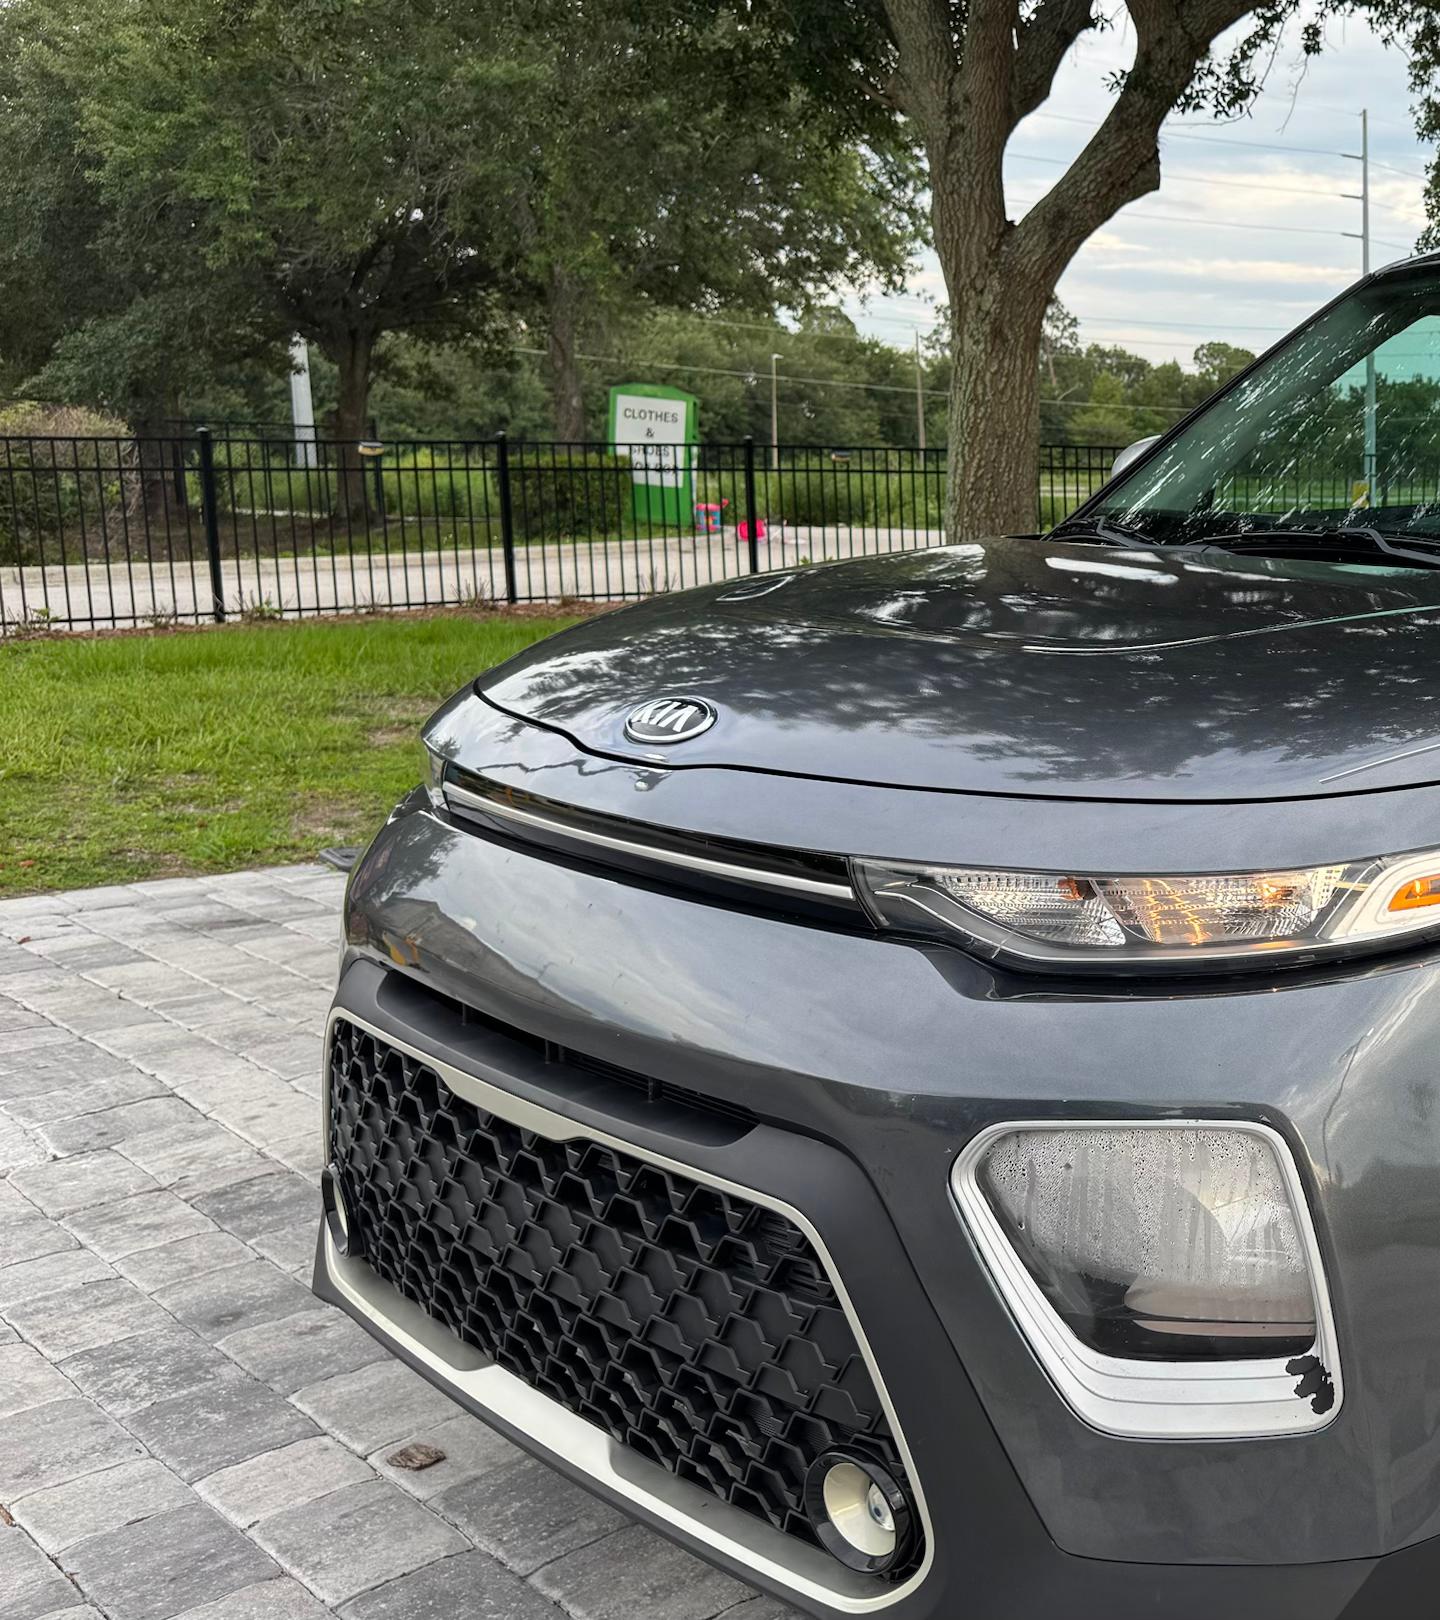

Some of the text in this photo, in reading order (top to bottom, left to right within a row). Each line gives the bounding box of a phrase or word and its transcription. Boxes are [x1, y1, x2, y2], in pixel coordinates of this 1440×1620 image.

[623, 407, 679, 424] CLOTHES
[646, 427, 655, 438] &
[630, 699, 699, 733] KIA
